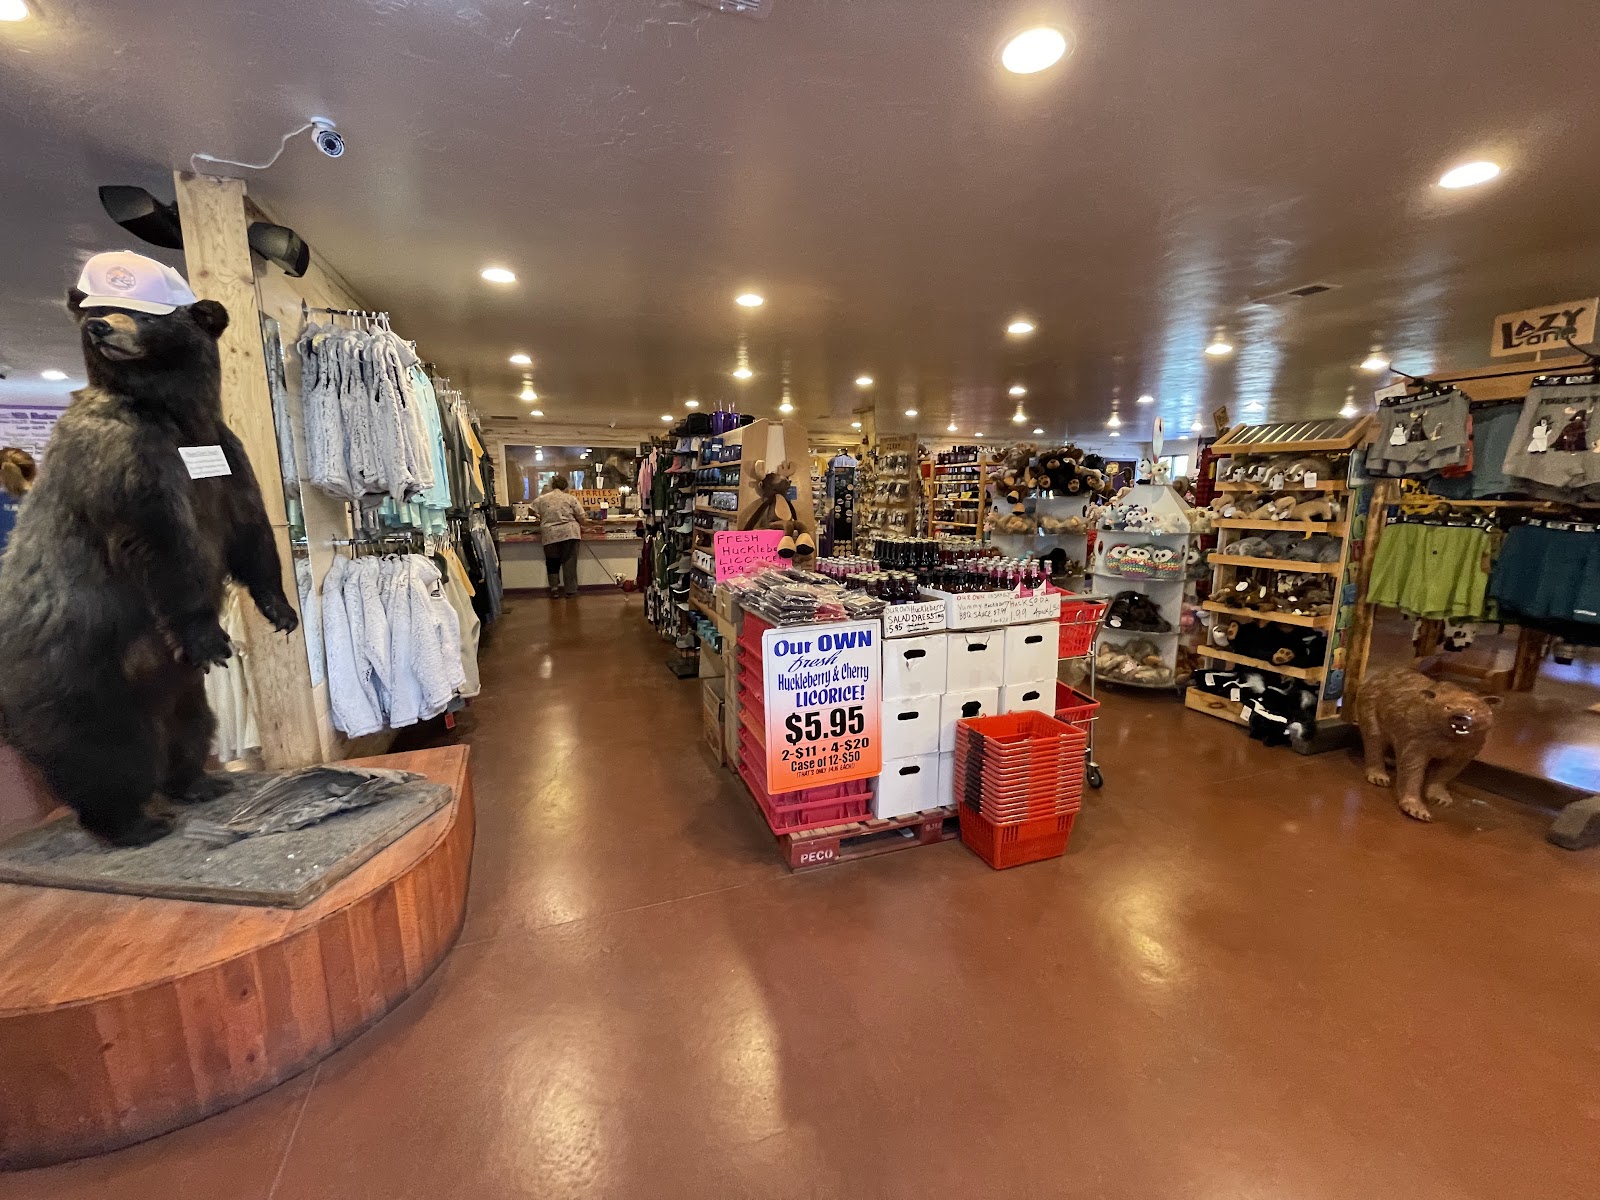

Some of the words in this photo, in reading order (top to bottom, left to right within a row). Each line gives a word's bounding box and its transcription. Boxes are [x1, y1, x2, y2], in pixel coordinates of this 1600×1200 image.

[1029, 597, 1049, 607] SODA
[887, 613, 911, 624] SALAD
[774, 640, 813, 657] Our
[817, 630, 872, 652] OWN
[788, 650, 842, 673] fresh
[778, 670, 831, 691] Huckleberry
[832, 665, 840, 682] &
[841, 662, 869, 682] Cherry
[796, 685, 865, 708] LICORICE!
[785, 705, 864, 746] $5.95
[781, 745, 817, 761] 2-$11
[831, 737, 870, 752] 4-$20
[791, 760, 815, 772] Case
[817, 756, 827, 767] of
[828, 750, 860, 766] 12-$50
[800, 849, 833, 864] PECO
